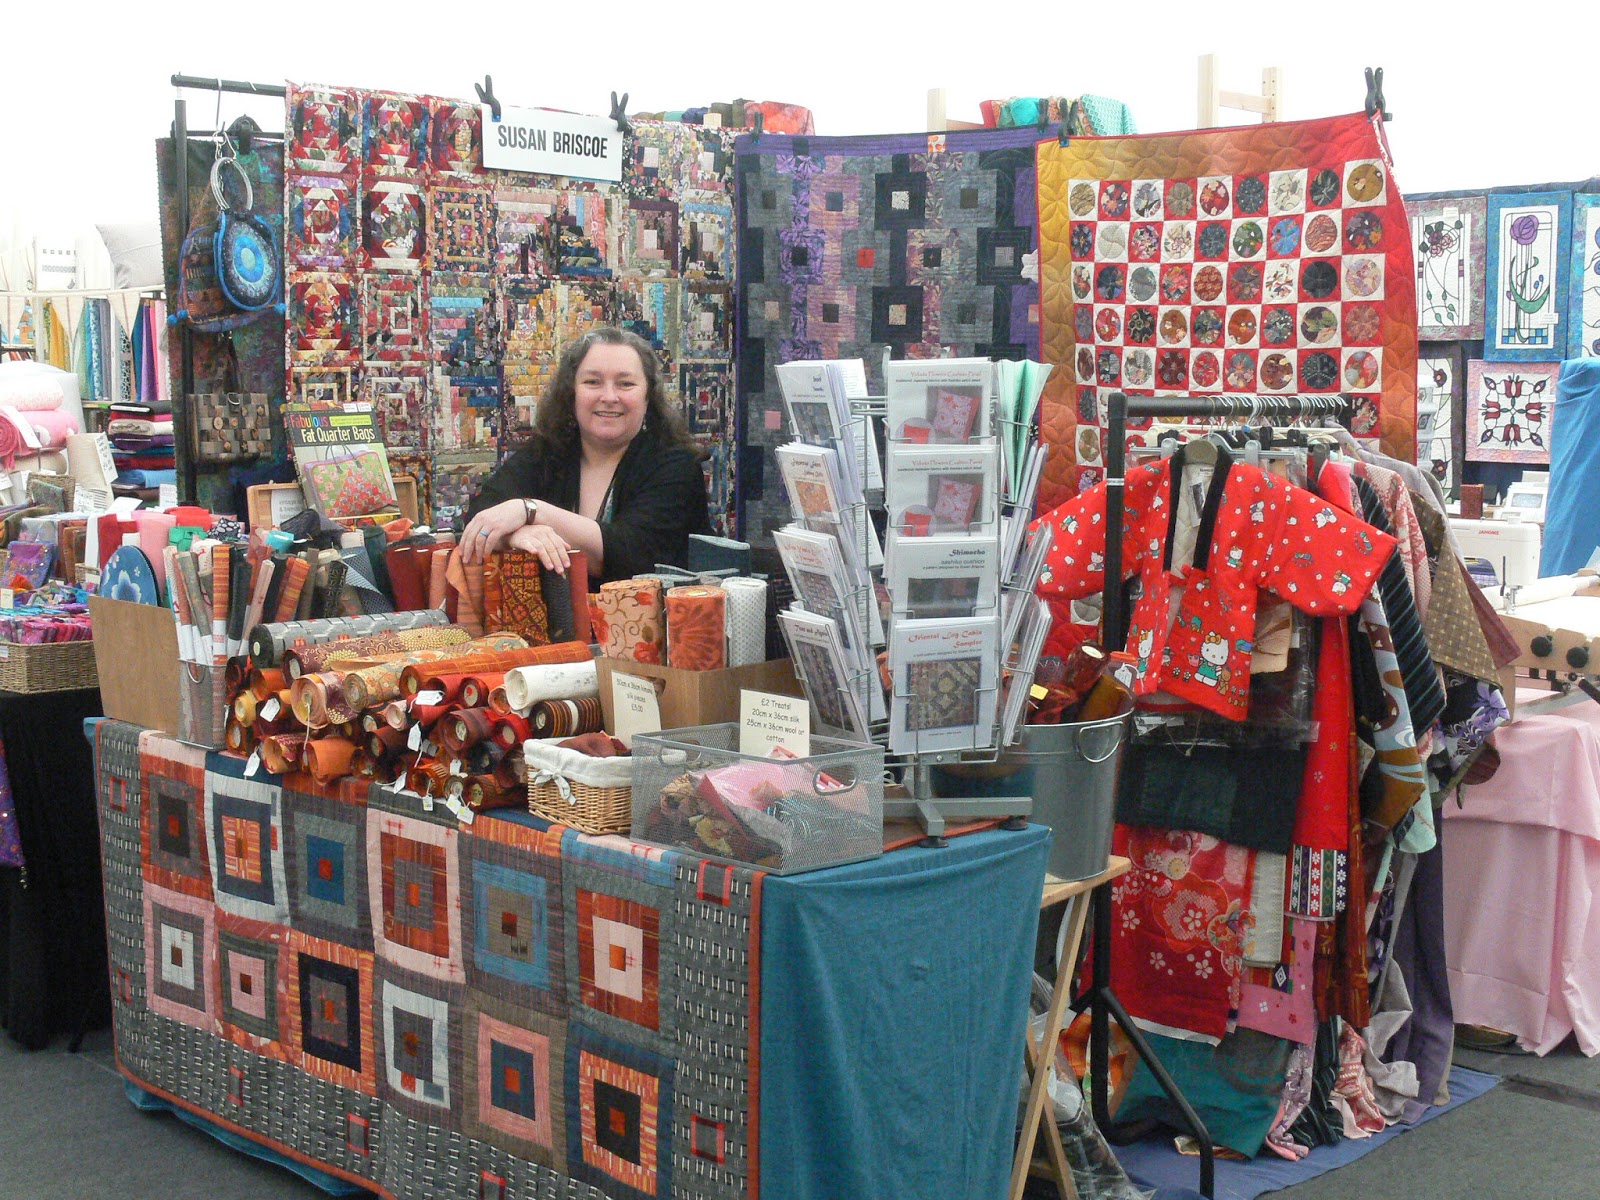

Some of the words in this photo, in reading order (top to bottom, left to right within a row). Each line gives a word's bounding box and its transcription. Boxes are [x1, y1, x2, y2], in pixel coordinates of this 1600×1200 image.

[498, 124, 546, 151] SUSAN
[553, 131, 608, 159] BRISCOE
[289, 413, 329, 429] Fabulous
[301, 428, 316, 443] Fat
[316, 427, 351, 442] Quarter
[352, 426, 375, 443] Bags
[761, 698, 769, 707] £2
[771, 699, 791, 710] Treats!
[752, 708, 767, 718] 20cm
[774, 711, 788, 721] 36cm
[790, 715, 800, 723] silk
[747, 718, 761, 728] 25cm
[769, 722, 783, 731] 36cm
[785, 725, 796, 734] wool
[766, 734, 785, 743] cotton
